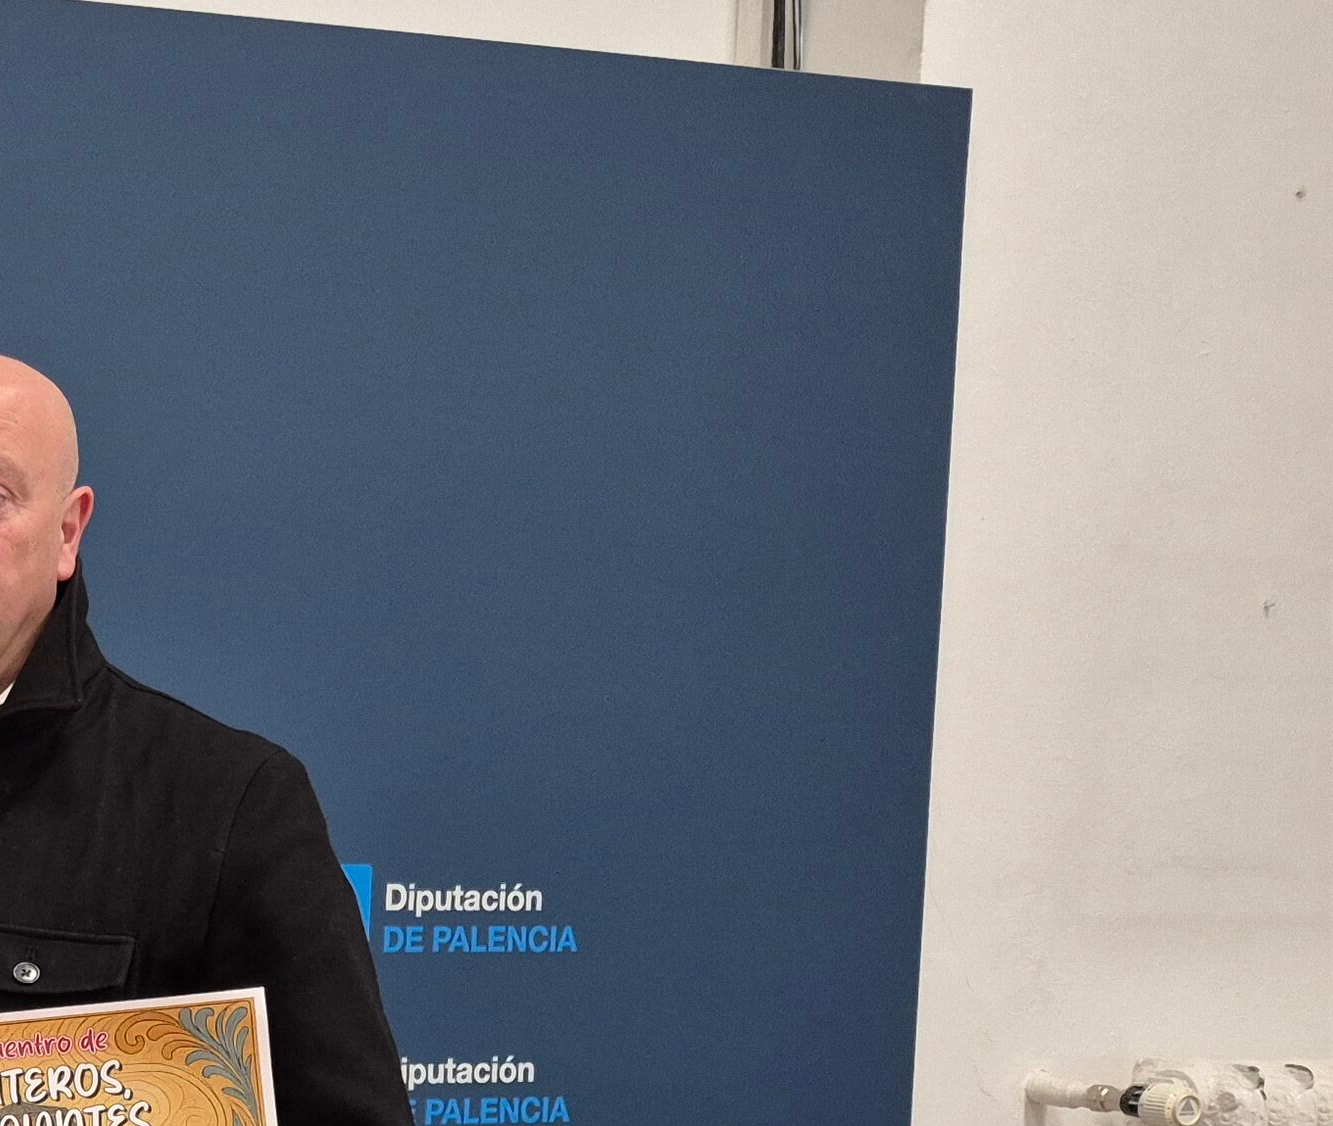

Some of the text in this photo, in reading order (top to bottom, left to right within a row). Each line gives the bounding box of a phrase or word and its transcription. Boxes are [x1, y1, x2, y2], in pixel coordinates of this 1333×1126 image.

[384, 882, 543, 917] Diputación
[383, 925, 578, 953] DE PALENCIA
[78, 1027, 109, 1052] de
[400, 1055, 535, 1091] iputación
[425, 1096, 570, 1126] PALENCIA
